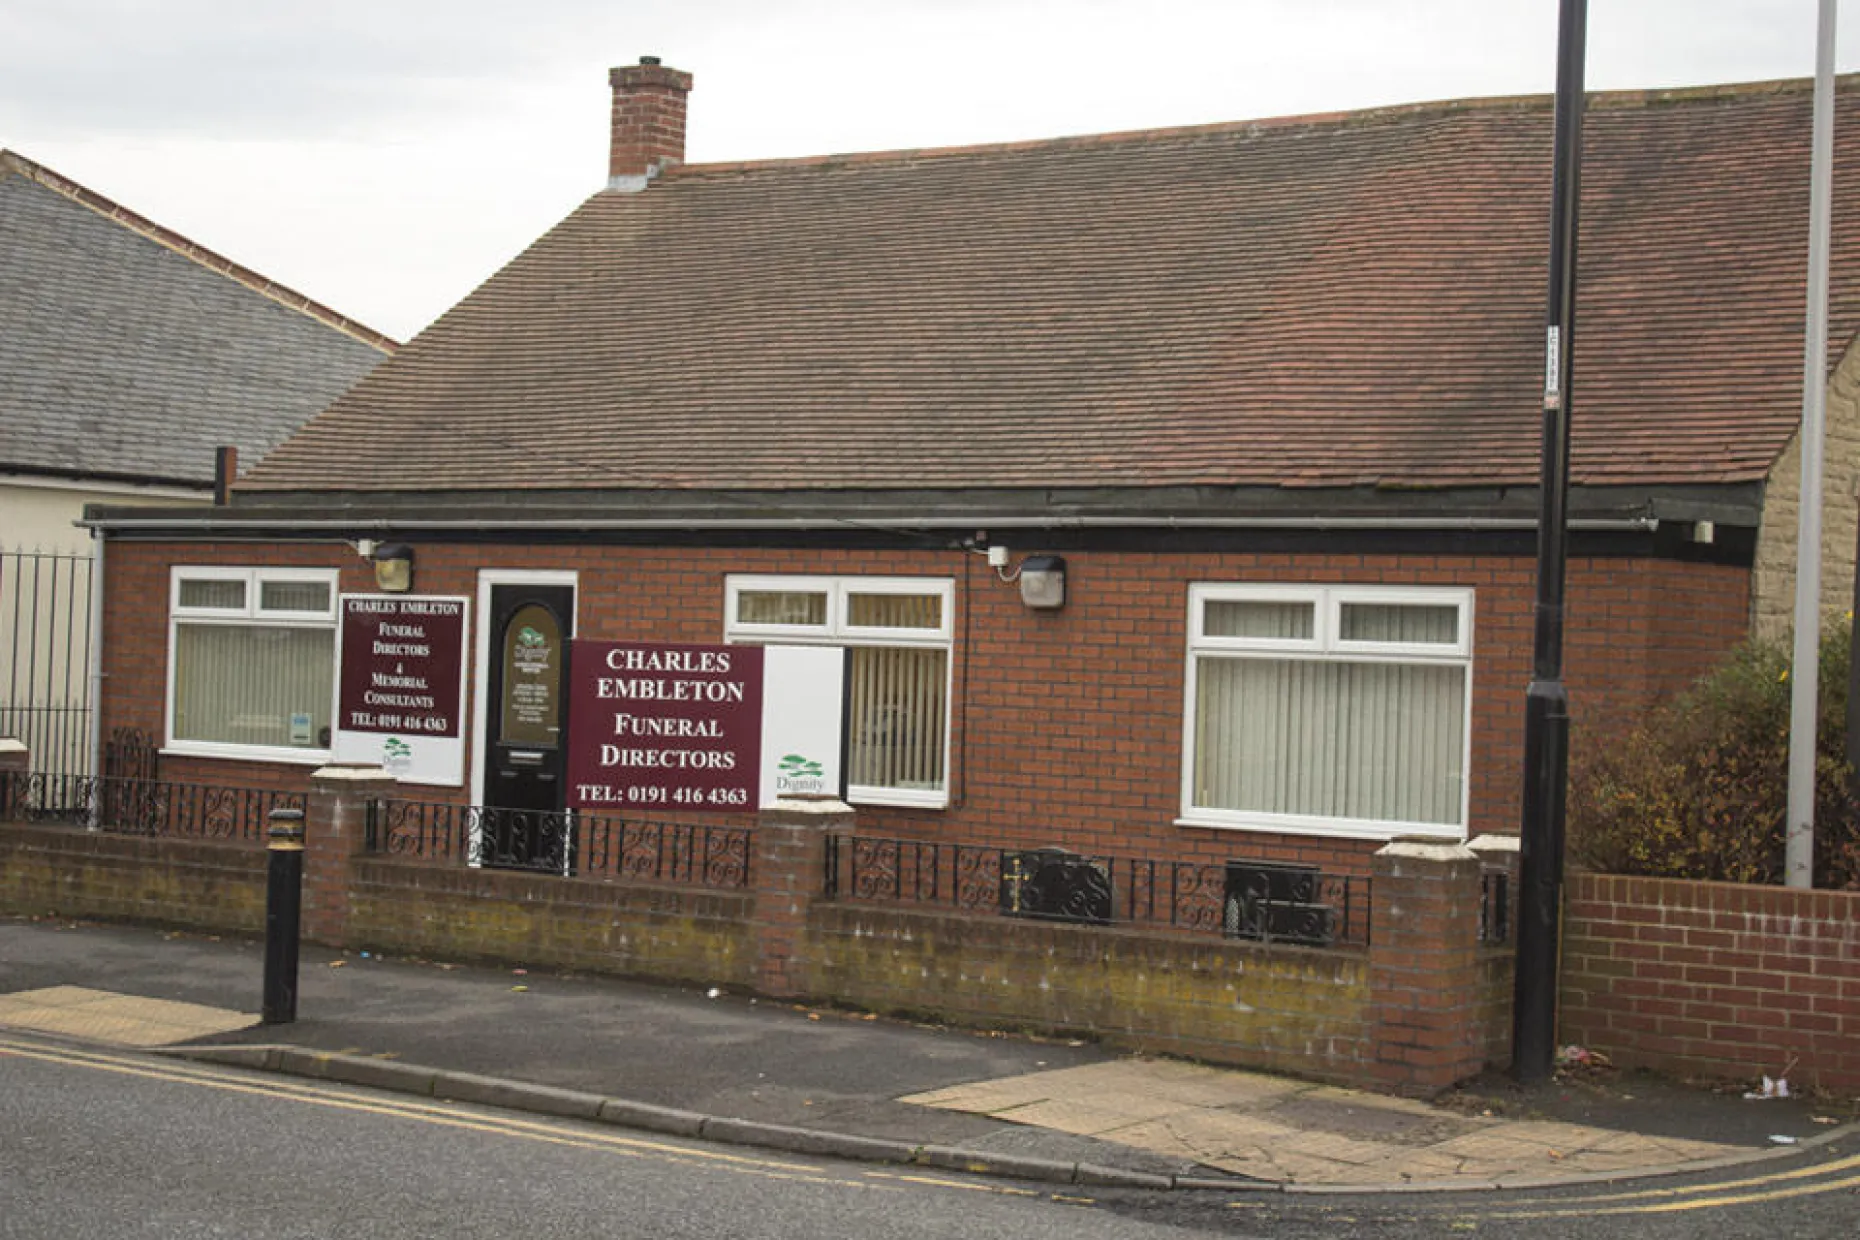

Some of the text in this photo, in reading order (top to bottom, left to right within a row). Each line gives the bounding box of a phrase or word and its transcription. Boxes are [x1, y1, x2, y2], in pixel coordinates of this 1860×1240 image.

[348, 600, 459, 615] CHARLES EMBLETON
[606, 649, 731, 674] CHARLES
[597, 677, 745, 702] EMBLETON
[351, 712, 376, 727] TEL:
[378, 714, 400, 729] 0191
[404, 716, 421, 730] 416
[614, 713, 723, 737] FUNERAL
[601, 744, 736, 769] DIRECTORS
[576, 784, 748, 804] TEL: 0191 416 4363
[776, 776, 824, 793] Dignity
